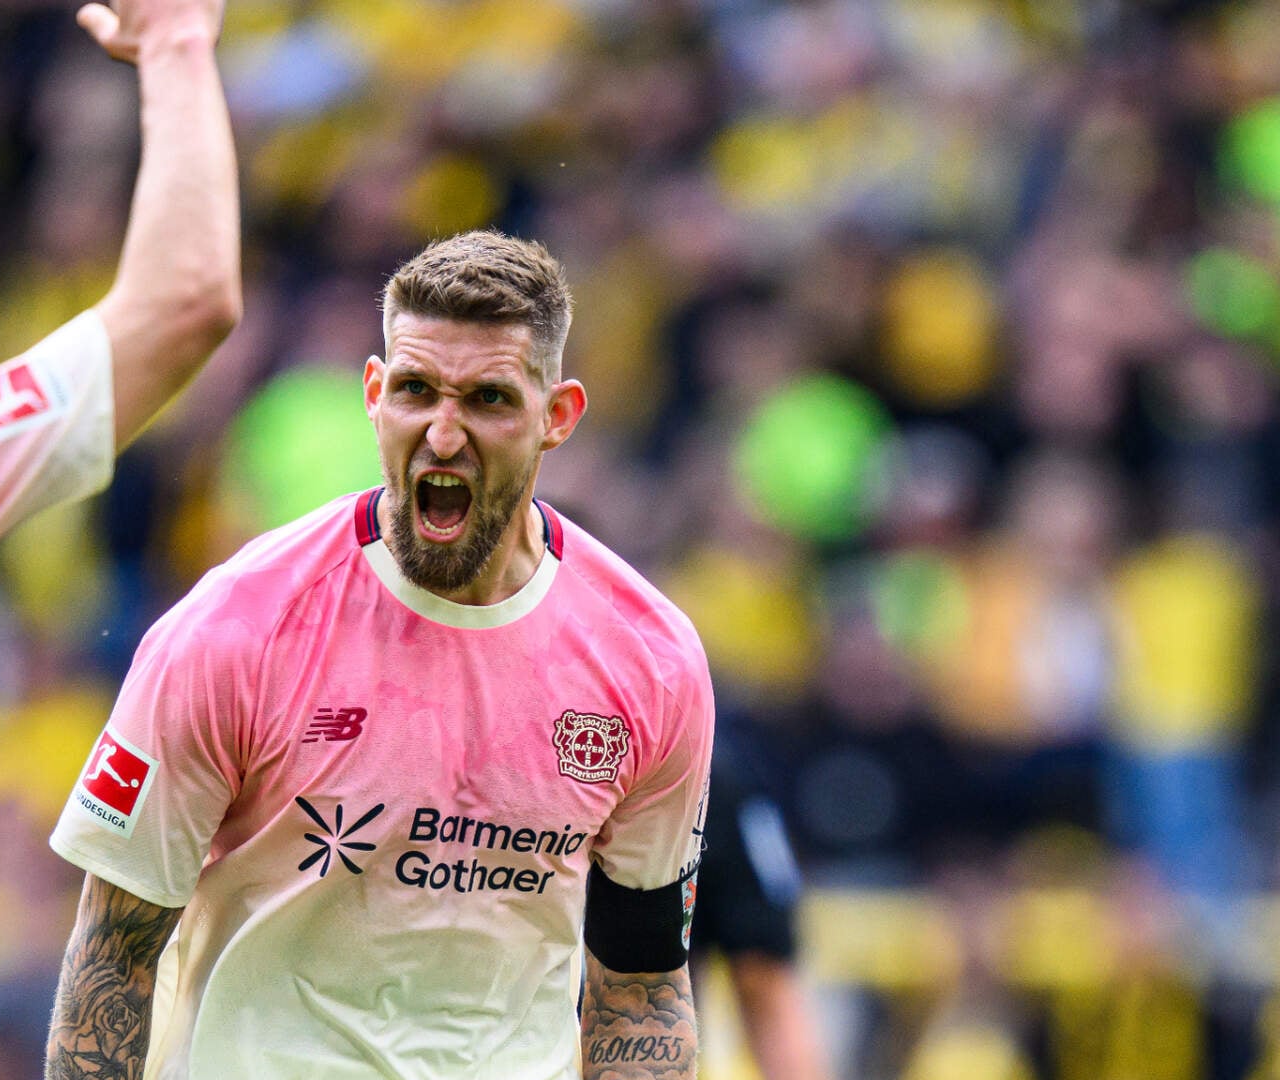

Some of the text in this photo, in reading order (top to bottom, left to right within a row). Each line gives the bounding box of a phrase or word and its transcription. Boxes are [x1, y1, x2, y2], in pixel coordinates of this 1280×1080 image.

[574, 743, 604, 754] BAYER
[564, 762, 611, 779] Leverkusen
[76, 790, 127, 830] NDESLIGA
[408, 807, 588, 856] Barmenia
[395, 850, 555, 894] Gothaer
